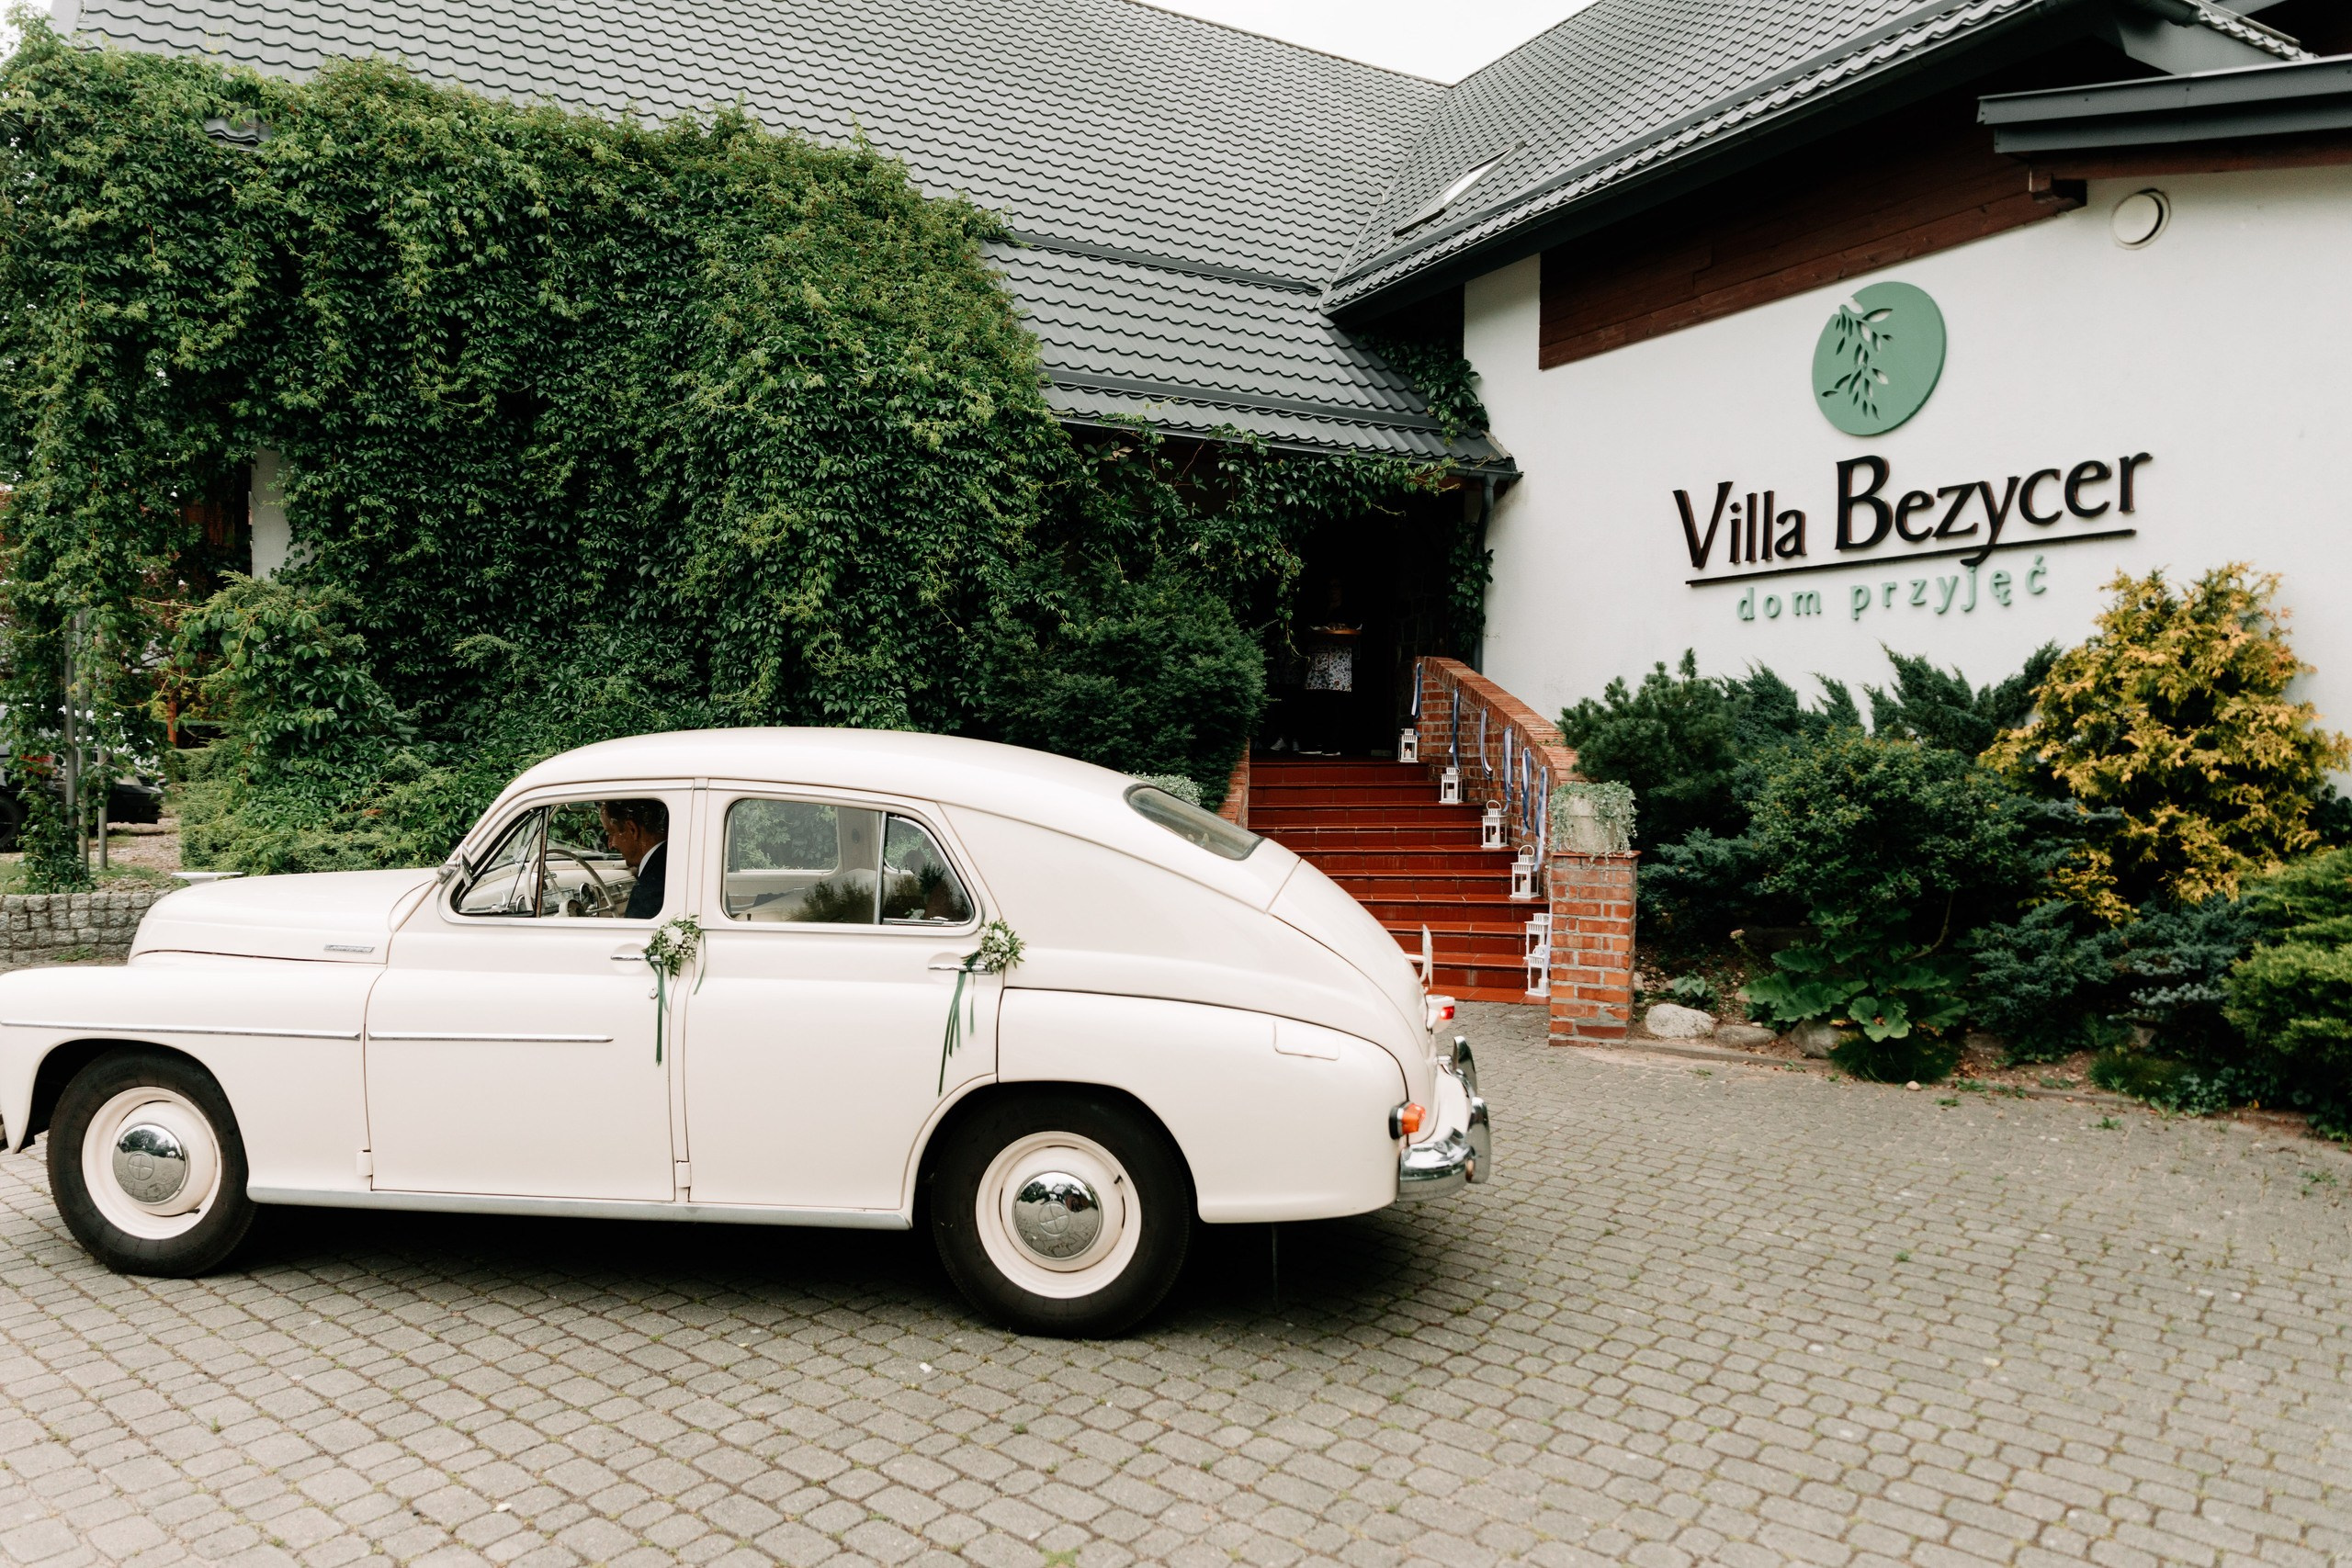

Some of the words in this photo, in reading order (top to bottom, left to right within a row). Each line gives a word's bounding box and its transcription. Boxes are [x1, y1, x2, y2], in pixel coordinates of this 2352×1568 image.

[1672, 480, 1807, 569] Villa
[1834, 451, 2153, 566] Bezycer
[1736, 586, 1822, 620] dom
[1849, 555, 2047, 620] przyjęć
